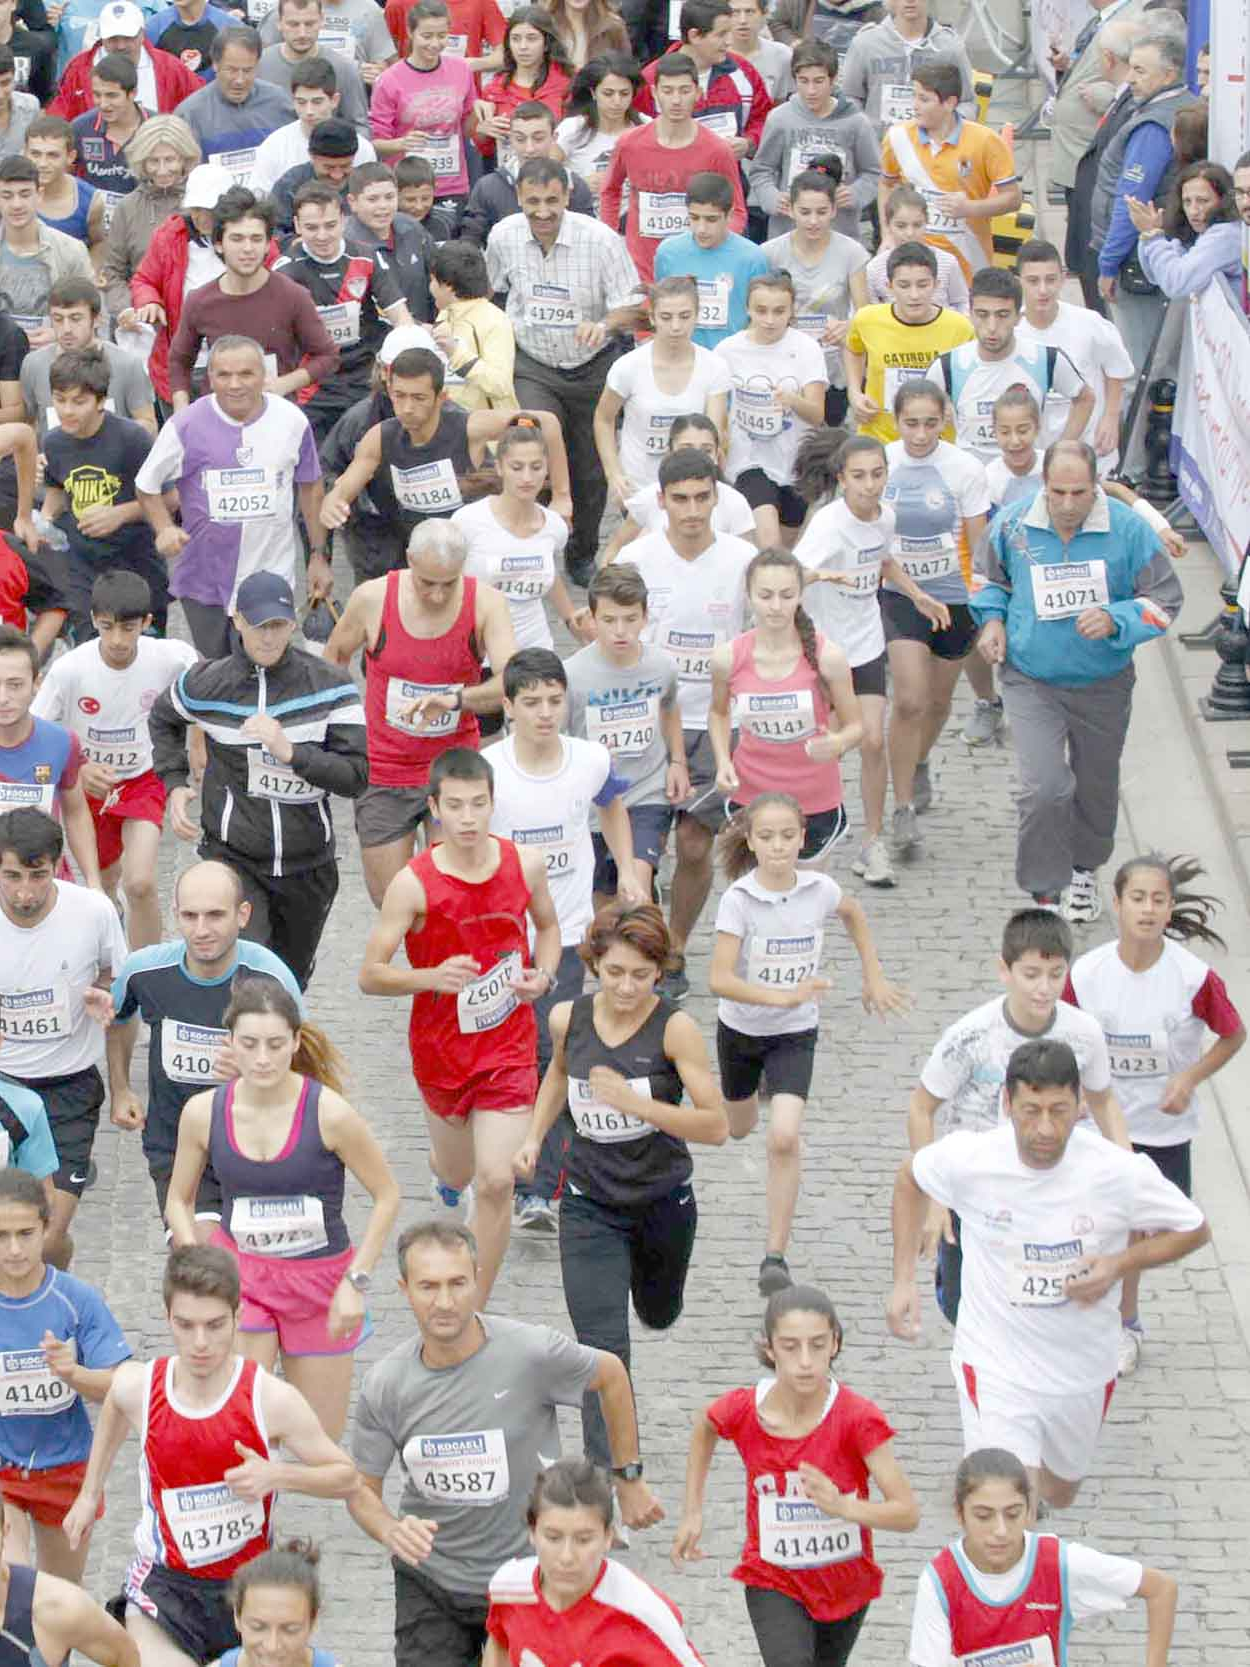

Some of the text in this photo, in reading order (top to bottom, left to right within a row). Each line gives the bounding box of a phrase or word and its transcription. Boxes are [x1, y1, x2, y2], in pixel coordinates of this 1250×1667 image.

[218, 494, 270, 512] 42052
[403, 487, 453, 506] 41184
[1044, 588, 1098, 608] 41071
[600, 728, 652, 748] 41740
[424, 1471, 495, 1493] 43587
[181, 1513, 256, 1553] 43785
[773, 1531, 851, 1558] 41440
